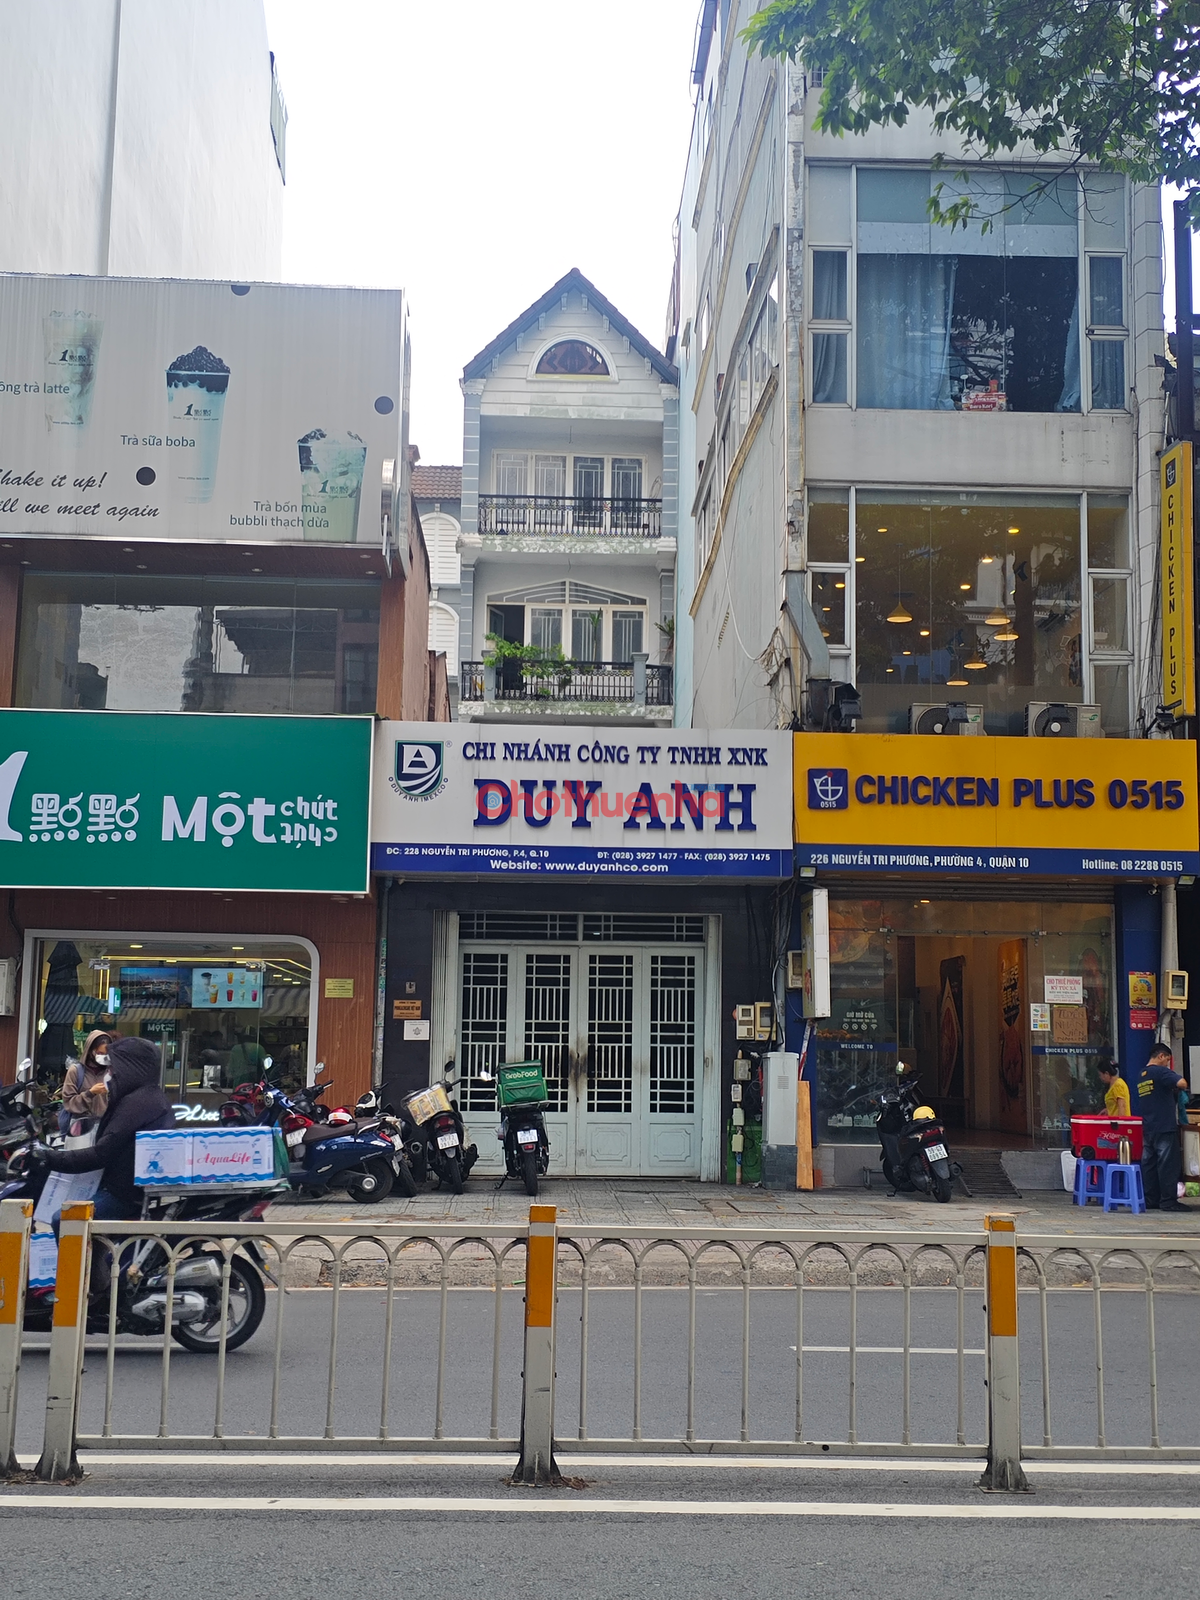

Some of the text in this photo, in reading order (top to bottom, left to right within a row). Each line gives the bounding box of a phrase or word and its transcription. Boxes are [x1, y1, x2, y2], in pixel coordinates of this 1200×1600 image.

[23, 381, 40, 393] trà
[43, 382, 70, 394] latte
[120, 434, 196, 448] Trà sữa boba
[51, 474, 67, 488] it
[72, 472, 108, 492] up!
[25, 502, 50, 514] we
[57, 502, 101, 516] meet
[106, 504, 160, 522] again
[253, 500, 327, 514] Trà bốn mùa
[229, 514, 330, 530] bubbli thạch dừa
[1167, 493, 1177, 695] CHICKEN PLUS
[462, 738, 768, 767] CHI NHÁNH CÔNG TY TNHH XNK
[854, 774, 1185, 811] CHICKEN PLUS 0515
[280, 794, 339, 821] chút
[473, 778, 757, 831] DUY ANH
[161, 791, 278, 848] Một
[386, 846, 550, 858] ĐC: 228 NGUYỄN TRI PHƯƠNG, P.4, Q.10
[611, 851, 634, 861] (028)
[636, 852, 656, 860] 3927
[658, 852, 678, 861] 1477
[684, 852, 702, 860] FAX:
[704, 853, 727, 862] (028)
[729, 853, 749, 861] 3927
[751, 853, 771, 861] 1475
[810, 850, 1029, 869] 226 NGUYỄN TRI PHƯƠNG, PHƯỜNG 4, QUẬN 10
[490, 859, 669, 873] Website: www.duyanhco.com
[1082, 859, 1183, 871] Hotline: 08 2288 0515
[505, 1070, 539, 1079] GrabFood
[197, 1152, 252, 1165] AquaLife
